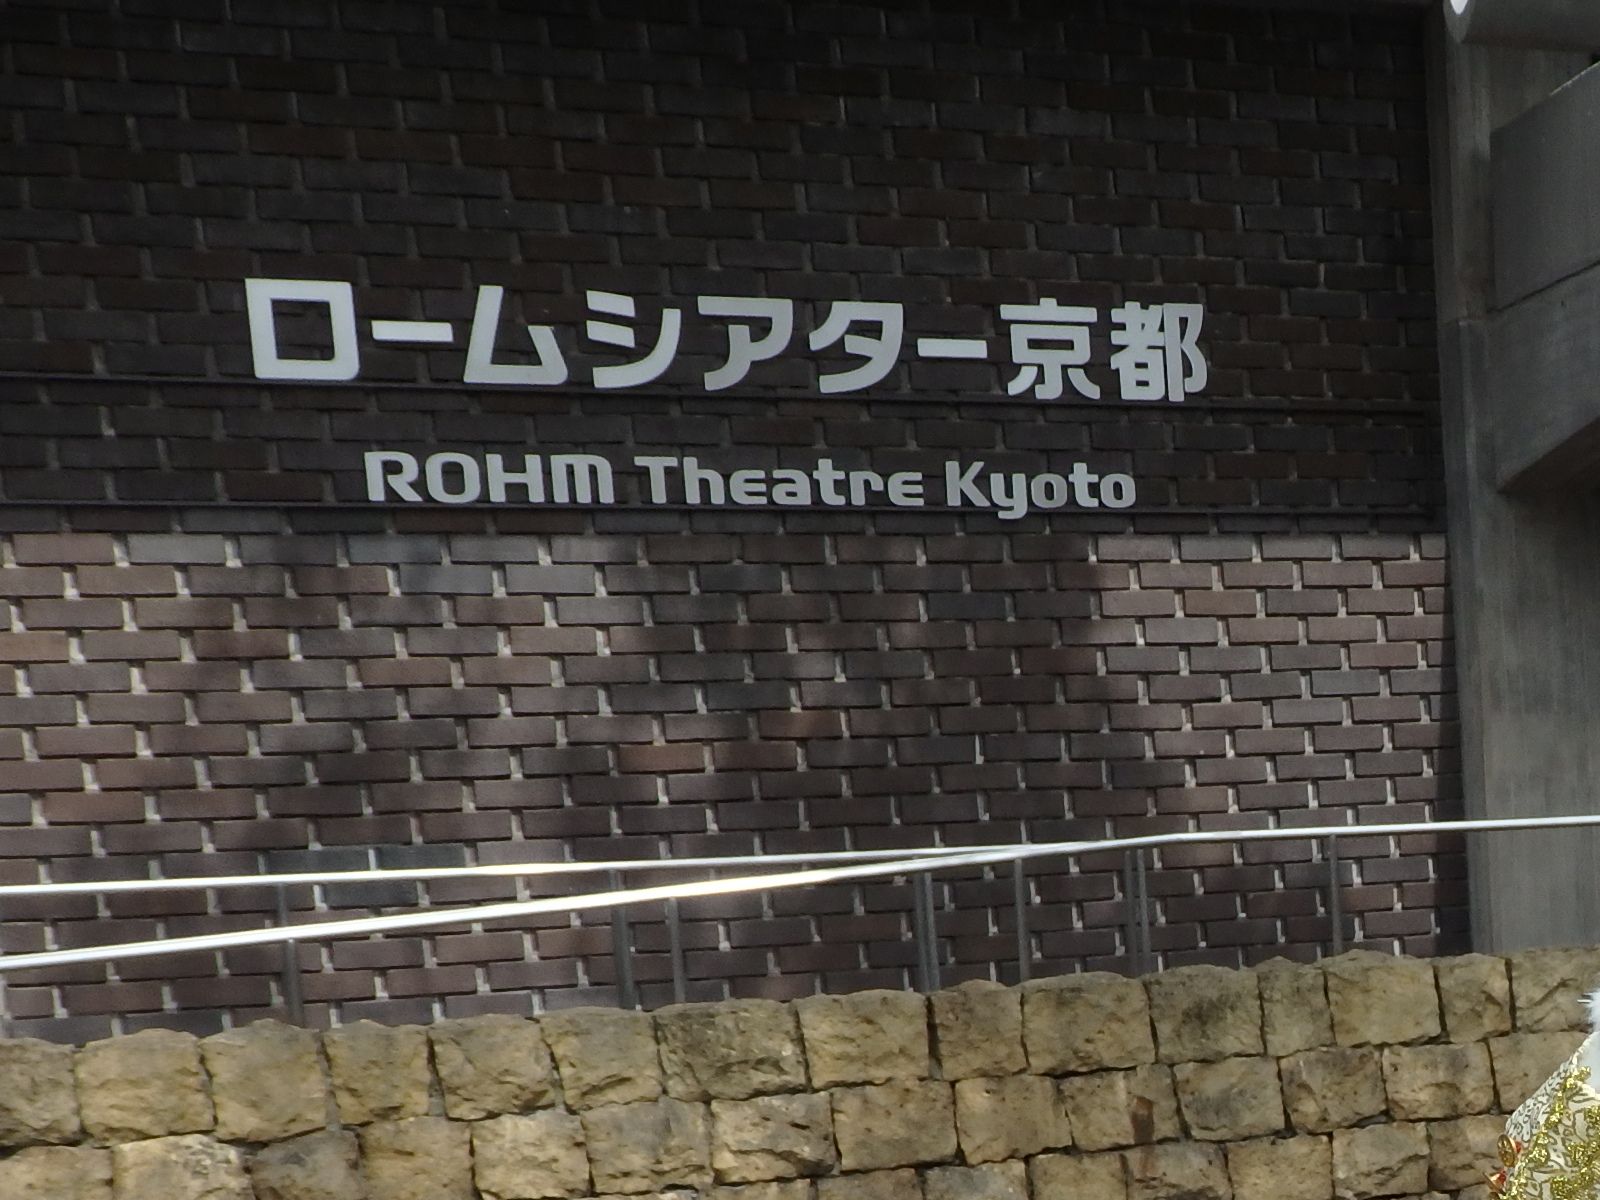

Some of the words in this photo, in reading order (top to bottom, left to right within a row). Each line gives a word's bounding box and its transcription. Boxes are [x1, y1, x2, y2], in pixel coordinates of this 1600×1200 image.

[244, 278, 1209, 402] ロームシアター京都
[363, 450, 614, 504] ROHM
[633, 455, 924, 507] Theatre
[945, 460, 1136, 520] Kyoto
